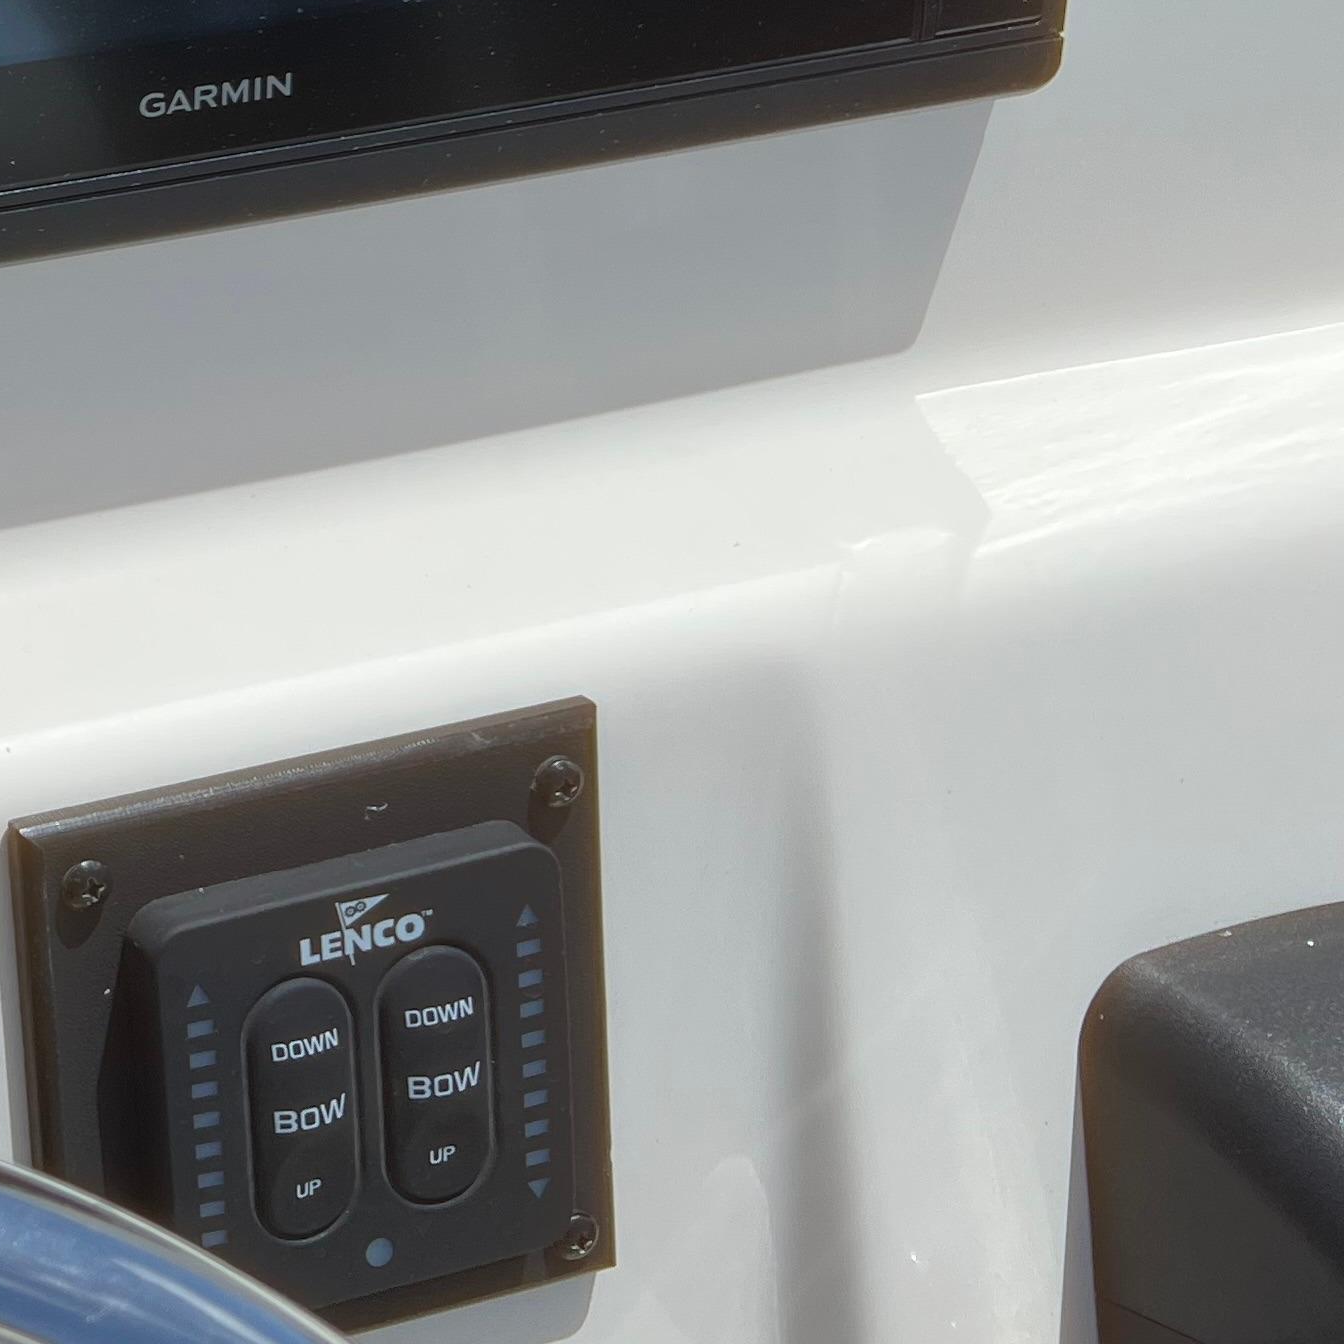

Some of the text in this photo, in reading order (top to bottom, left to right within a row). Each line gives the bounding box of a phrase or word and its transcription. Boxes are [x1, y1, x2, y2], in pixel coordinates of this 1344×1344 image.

[139, 72, 292, 118] GARMIN
[404, 996, 474, 1029] DOWN
[271, 1029, 339, 1063] DOWN
[407, 1061, 481, 1100] BOW
[273, 1093, 346, 1135] BOW
[429, 1145, 456, 1165] UP
[296, 1179, 322, 1200] UP
